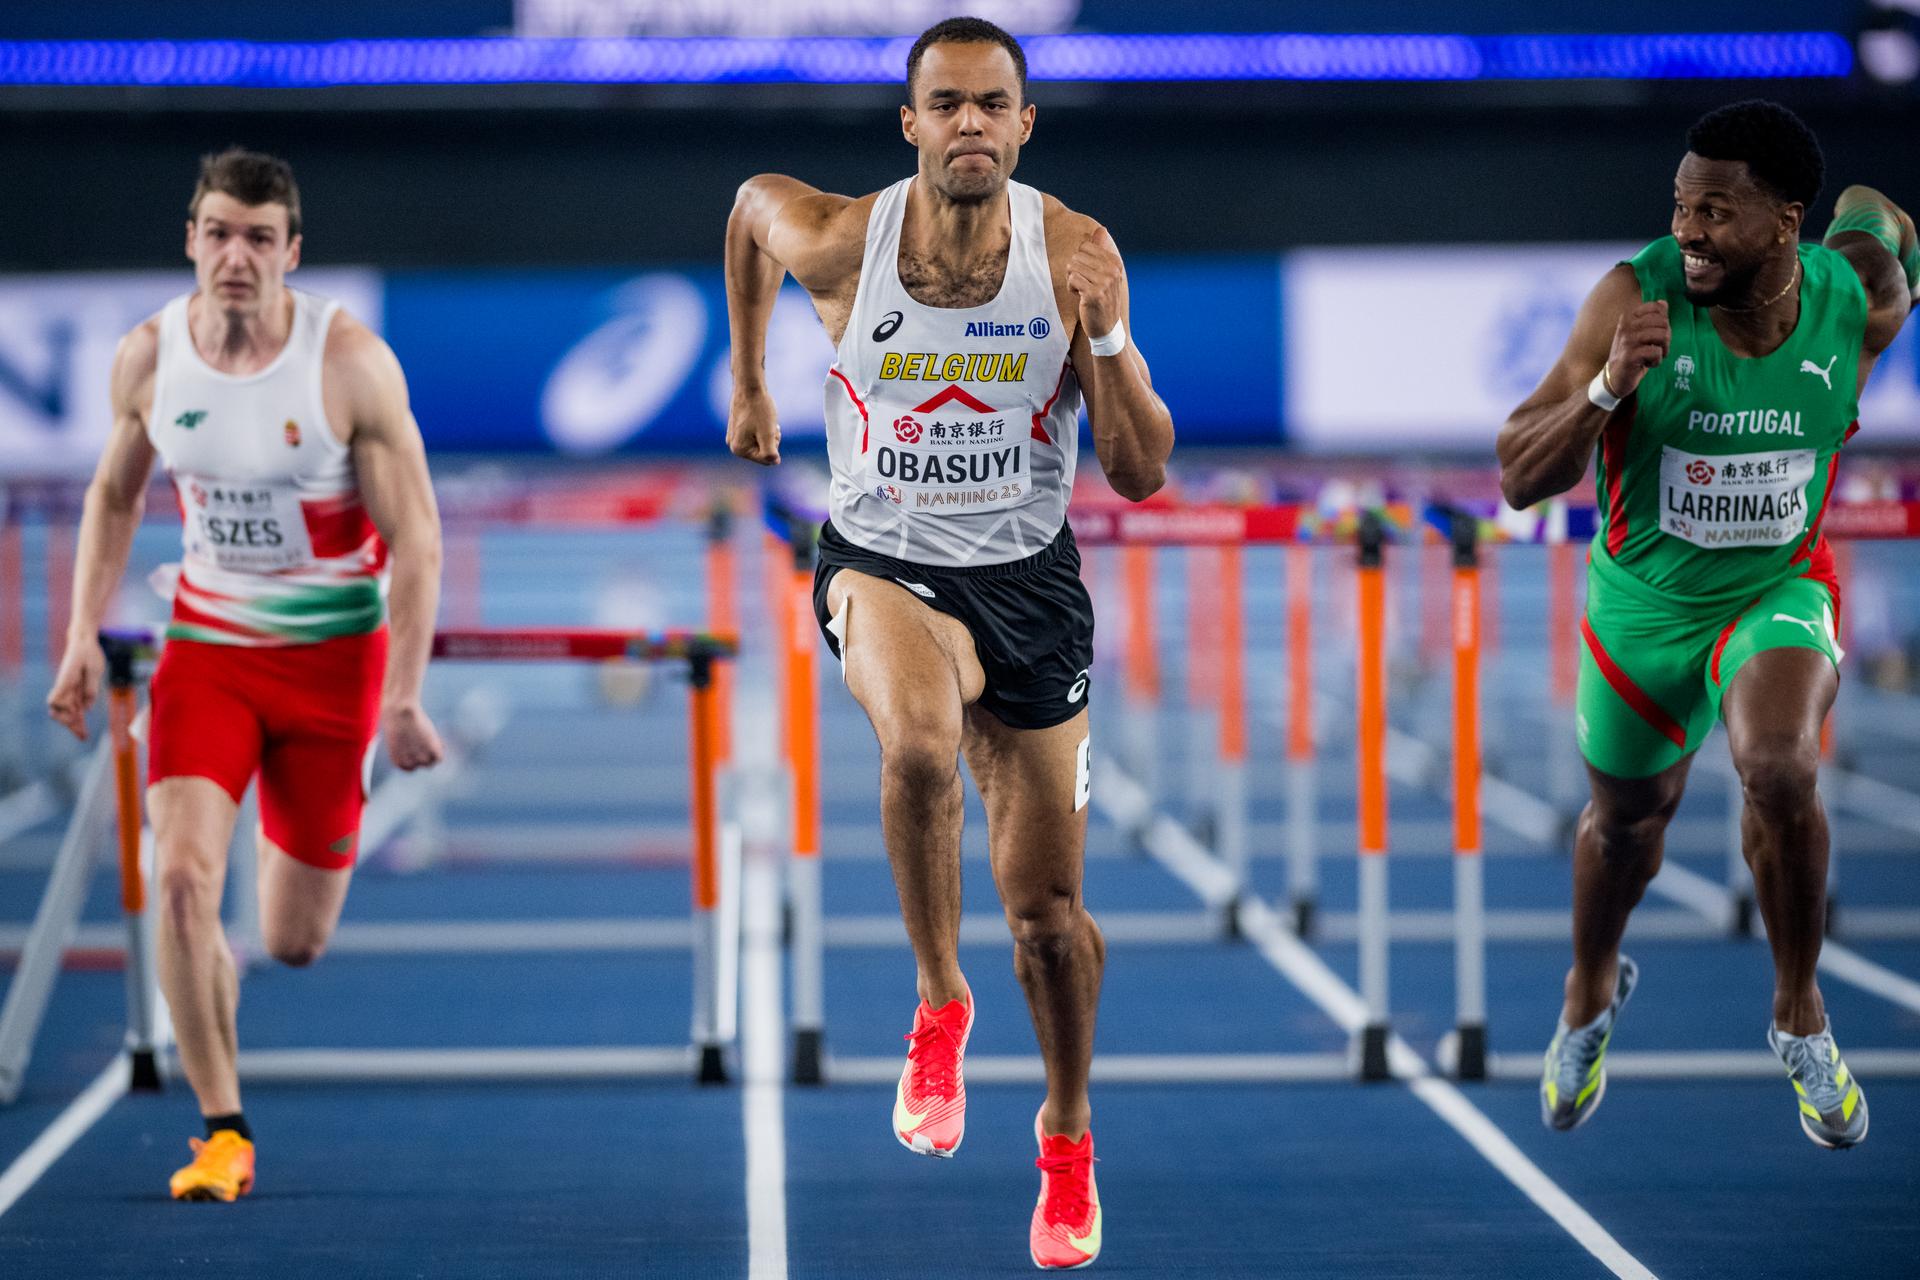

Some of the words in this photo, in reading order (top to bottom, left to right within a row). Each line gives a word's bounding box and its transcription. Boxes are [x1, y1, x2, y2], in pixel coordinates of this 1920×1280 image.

[965, 322, 1025, 337] Allianz
[879, 352, 1029, 382] BELGIUM
[1688, 409, 1805, 437] PORTUGAL
[969, 437, 1004, 445] NANJING
[877, 445, 1021, 484] OBASUYI
[916, 489, 998, 507] NANJING
[1001, 483, 1022, 500] 25
[1668, 486, 1802, 523] LARRINAGA
[1704, 527, 1782, 544] NANJING
